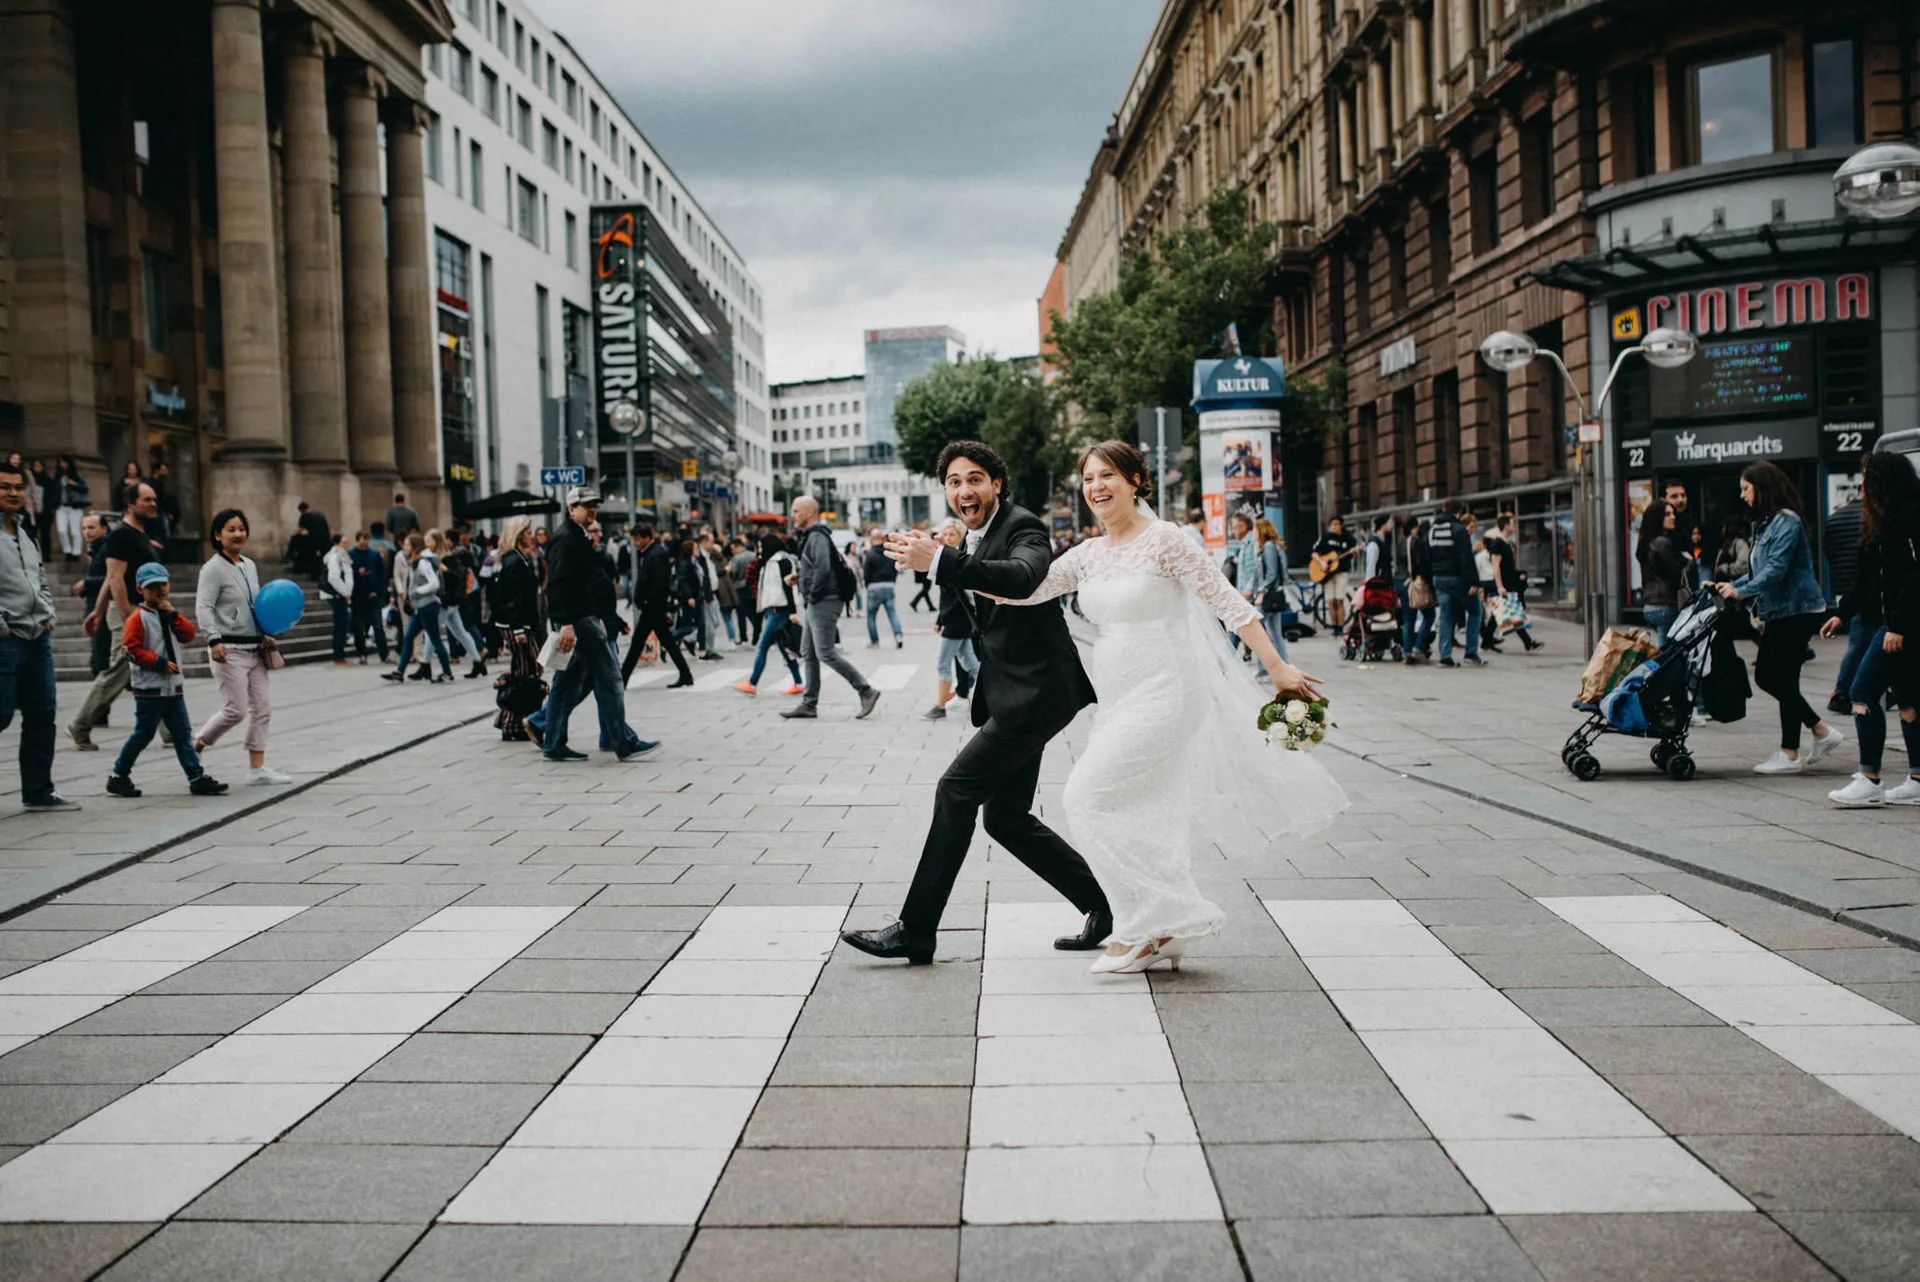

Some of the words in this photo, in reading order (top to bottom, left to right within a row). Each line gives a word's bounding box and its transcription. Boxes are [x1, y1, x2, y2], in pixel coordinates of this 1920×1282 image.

[1646, 273, 1870, 336] CINEMA
[599, 281, 638, 415] SATURN
[1216, 376, 1270, 393] KULTUR
[1677, 434, 1783, 463] marquardts
[1837, 431, 1863, 452] 22
[1629, 448, 1645, 467] 22
[557, 469, 580, 484] WC
